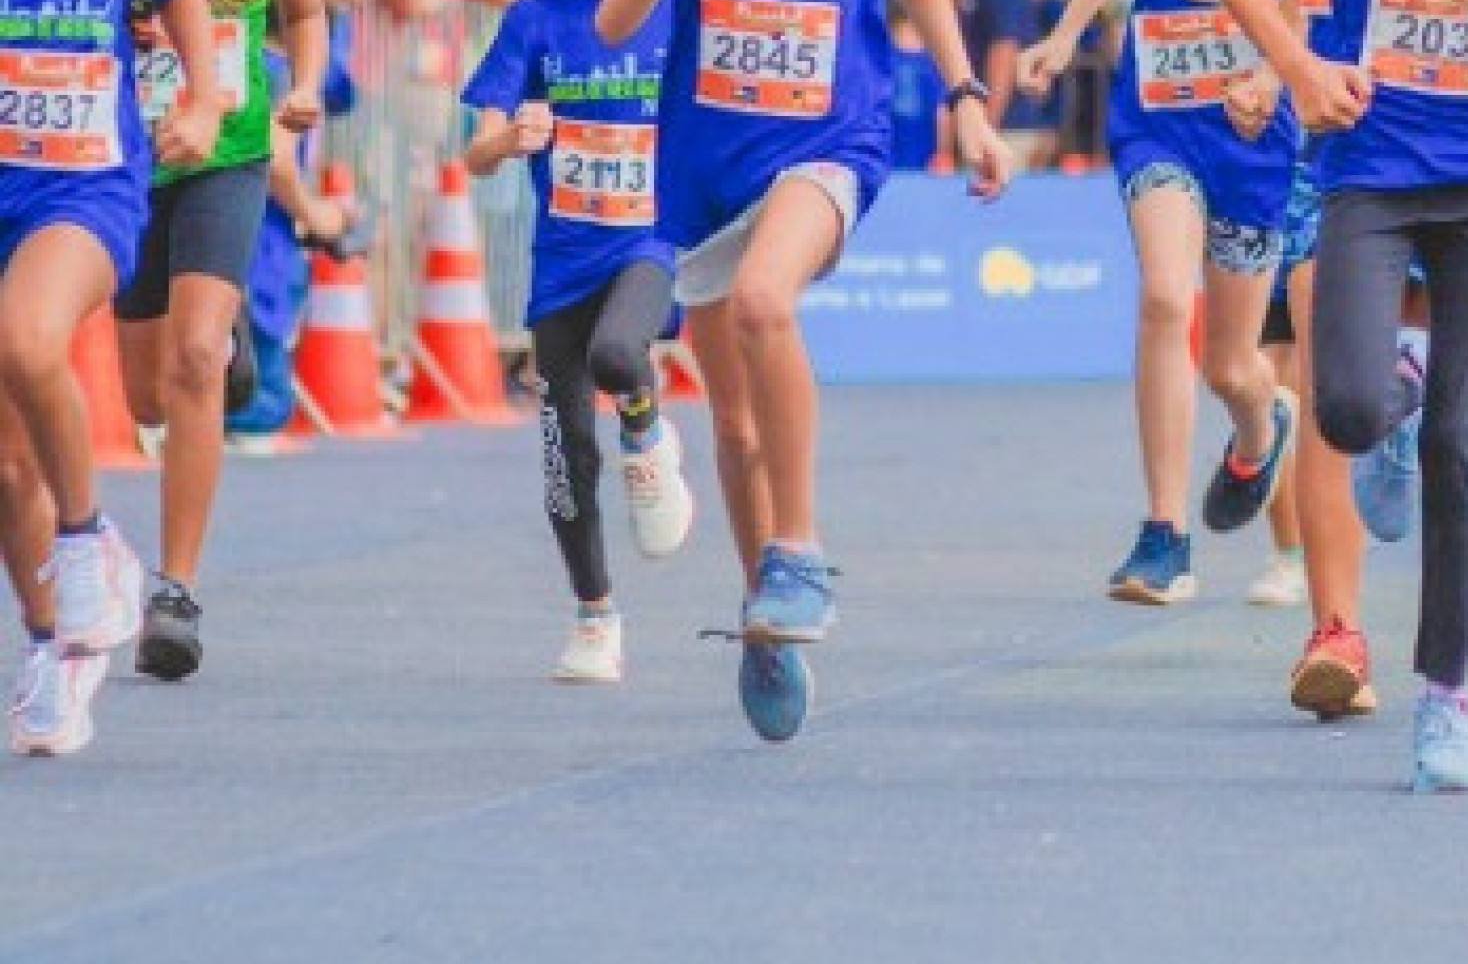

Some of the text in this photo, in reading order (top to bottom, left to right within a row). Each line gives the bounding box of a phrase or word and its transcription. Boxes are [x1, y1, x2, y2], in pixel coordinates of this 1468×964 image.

[712, 35, 820, 78] 2845
[1154, 43, 1237, 79] 2413
[0, 90, 95, 130] 2837
[565, 153, 647, 193] 2113
